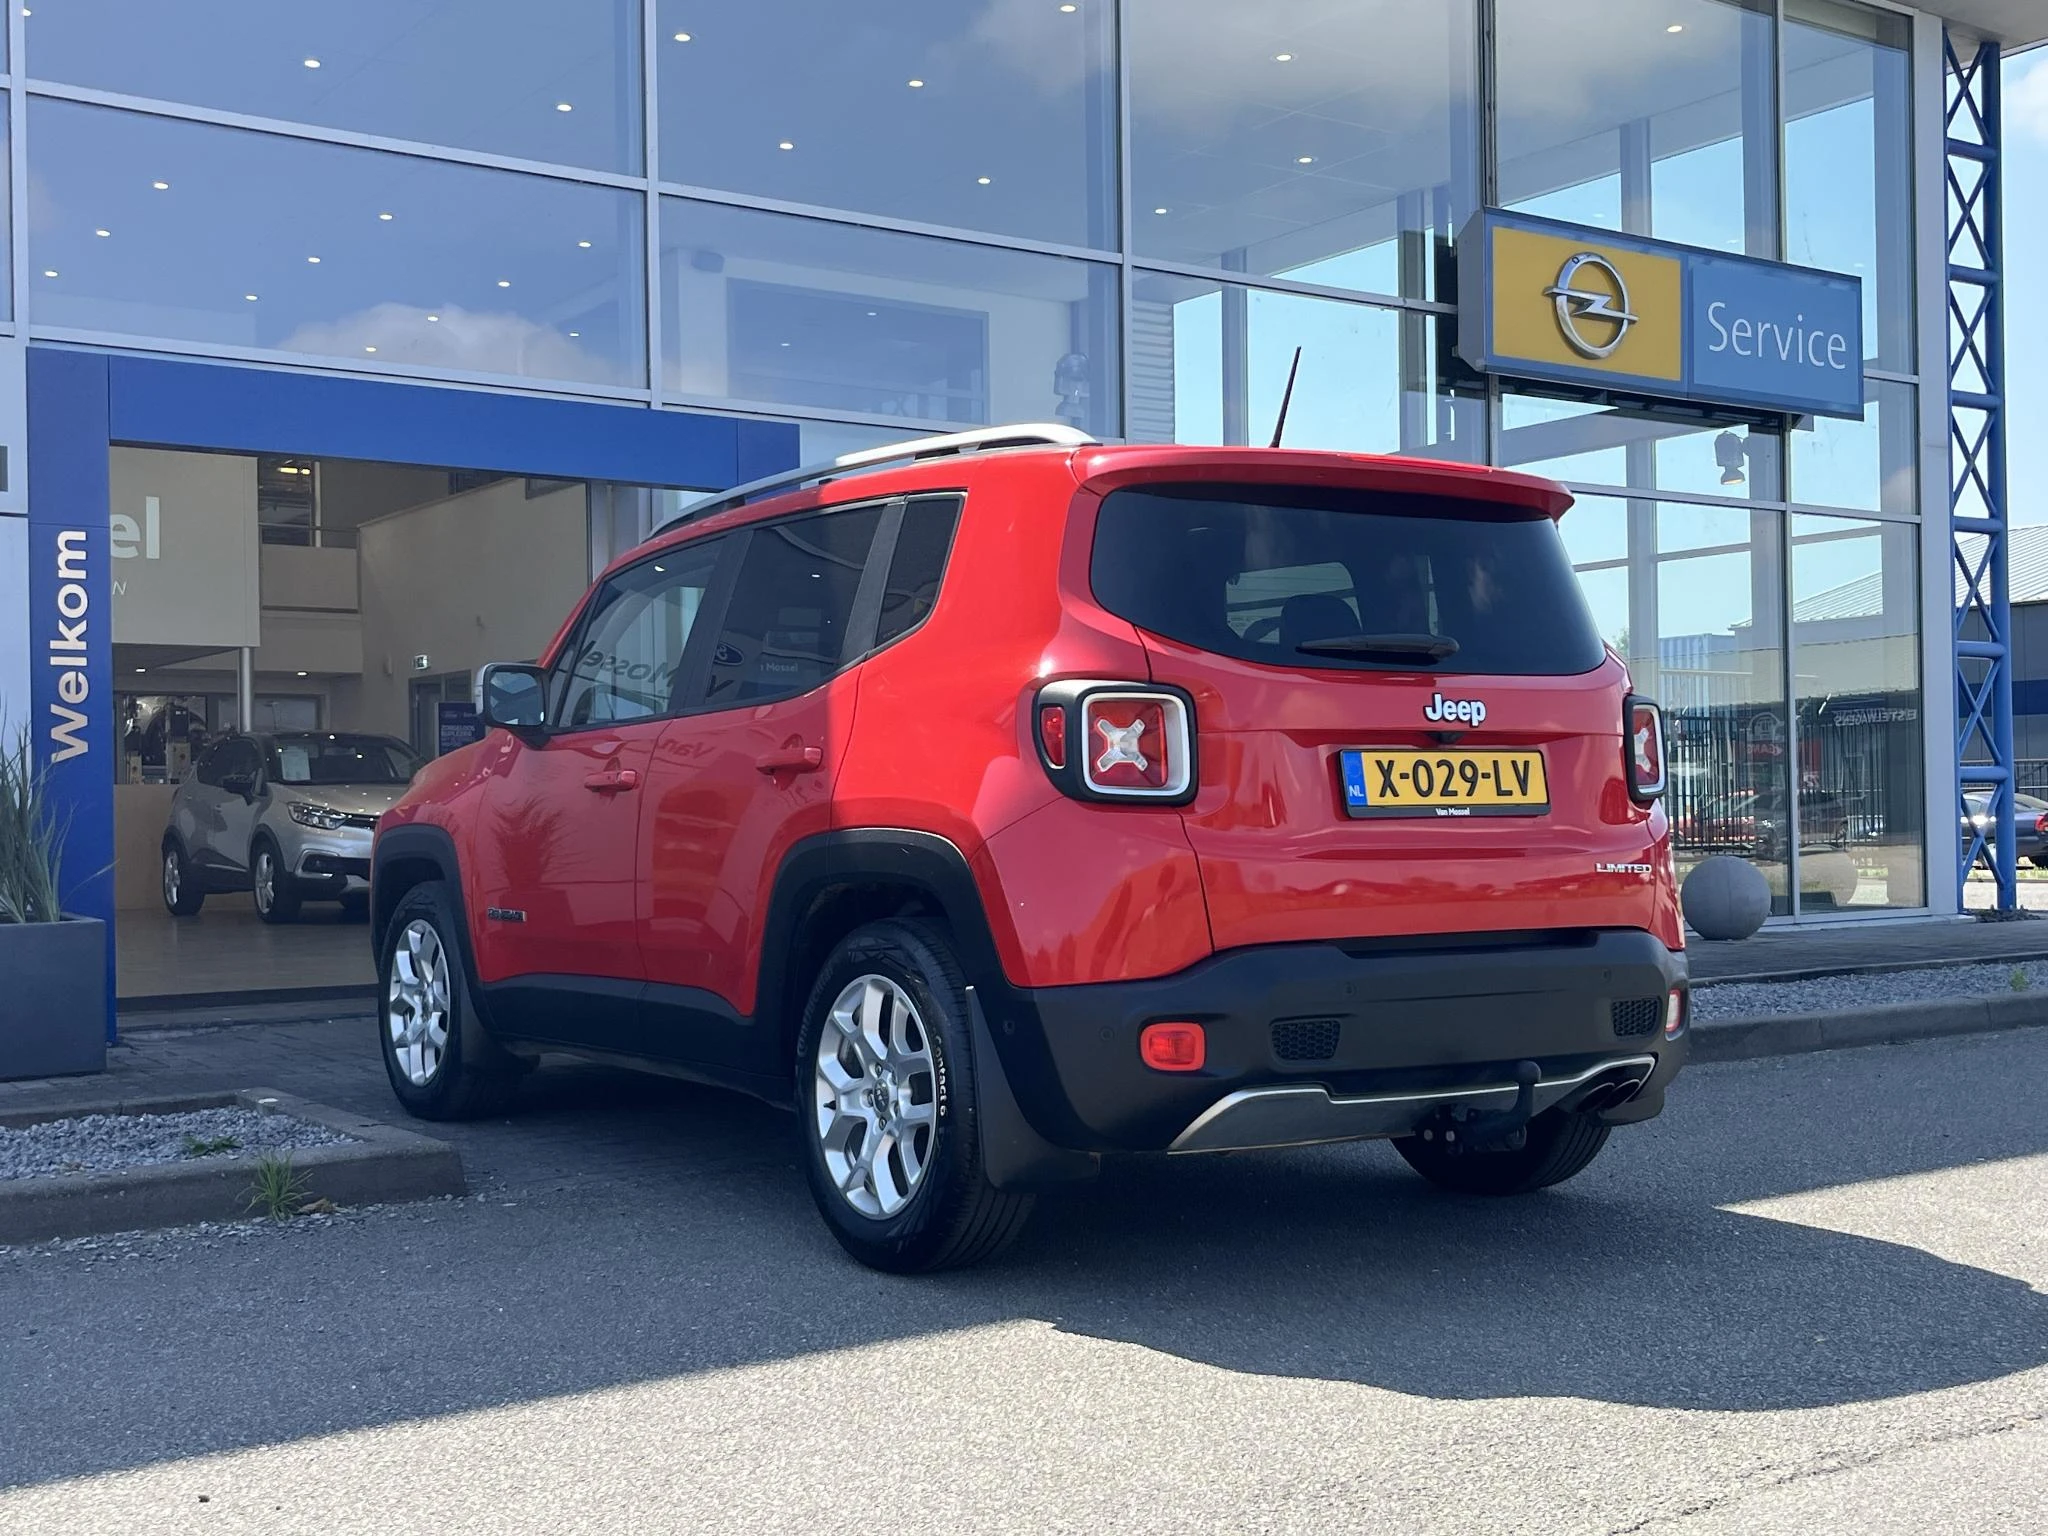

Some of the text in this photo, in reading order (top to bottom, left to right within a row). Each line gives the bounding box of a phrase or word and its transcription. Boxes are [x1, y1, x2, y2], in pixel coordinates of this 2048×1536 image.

[1708, 302, 1846, 370] Service
[50, 530, 89, 762] Welkom
[1424, 693, 1487, 727] Jeep
[1349, 785, 1364, 797] NL
[1376, 760, 1530, 797] X-029-LV
[1436, 807, 1471, 816] Van Mossel
[1596, 862, 1652, 873] LIMITED
